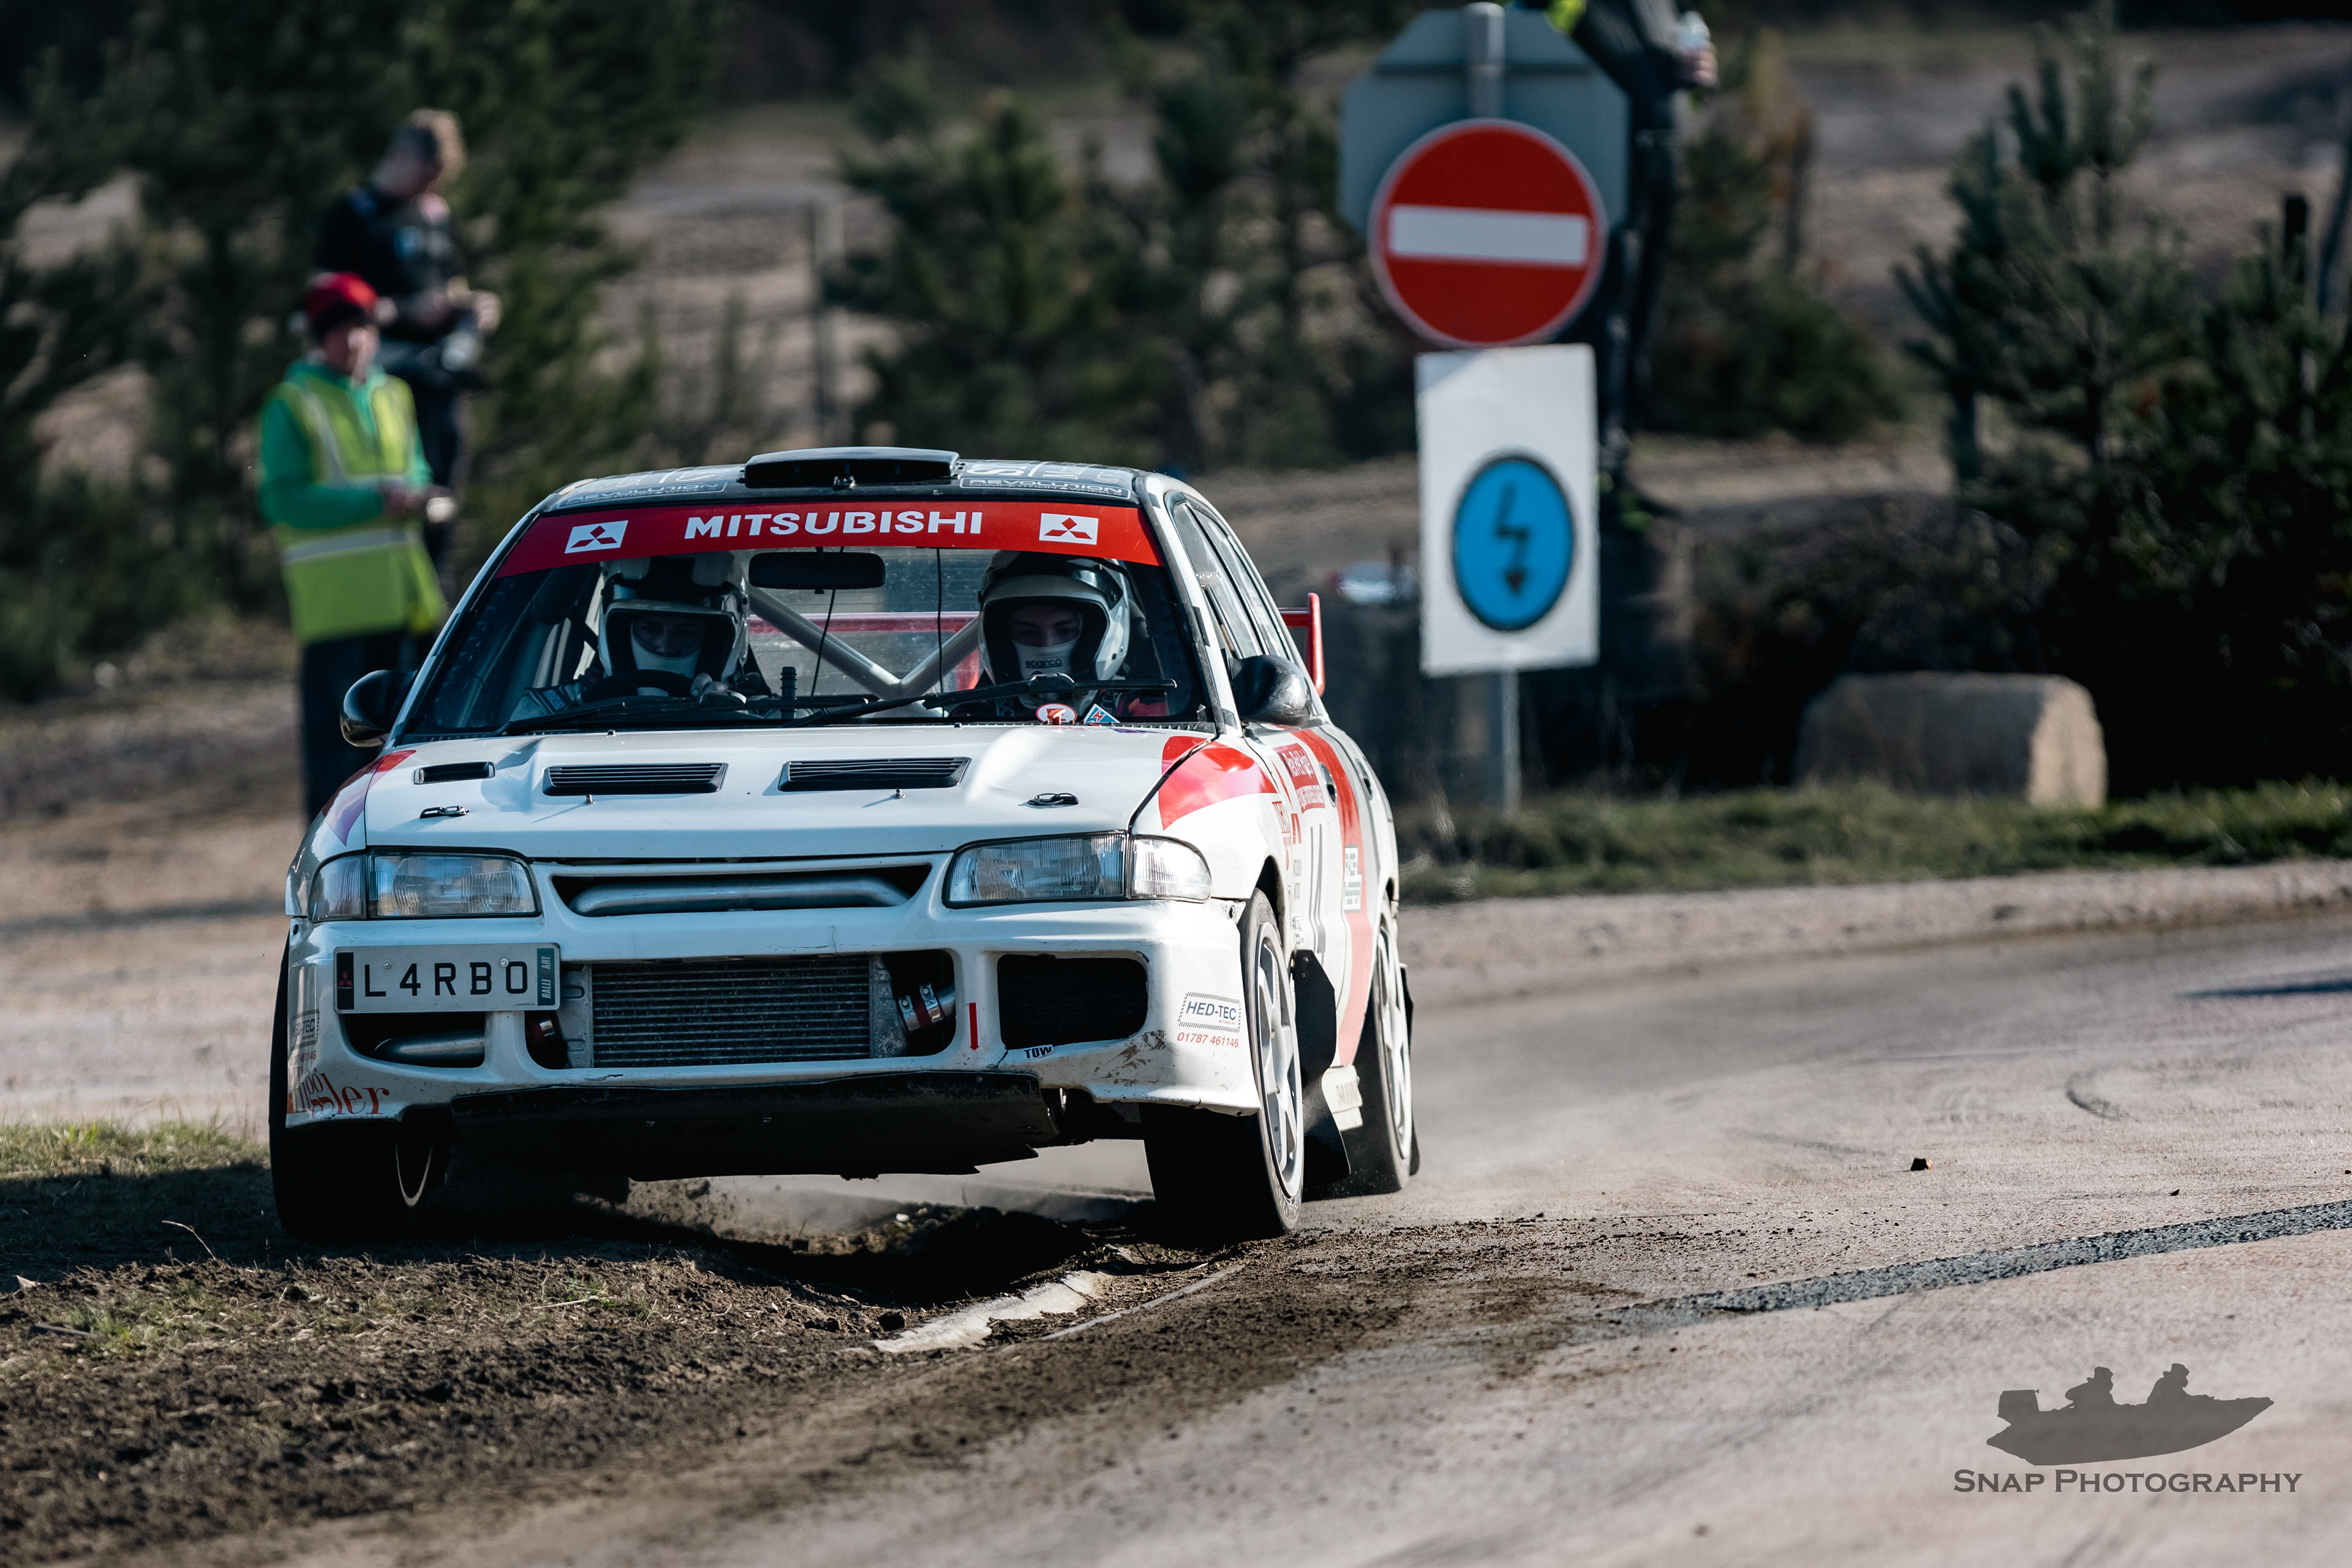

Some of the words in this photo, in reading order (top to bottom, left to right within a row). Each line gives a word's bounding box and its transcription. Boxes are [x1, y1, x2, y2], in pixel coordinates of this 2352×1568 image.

[684, 511, 982, 540] MITSUBISHI
[1025, 658, 1062, 668] sparco
[541, 956, 551, 970] ART
[1185, 1001, 1237, 1021] HED-TEC
[1177, 1032, 1208, 1044] 01787
[1210, 1035, 1239, 1048] 461146
[1023, 1046, 1052, 1059] TOW
